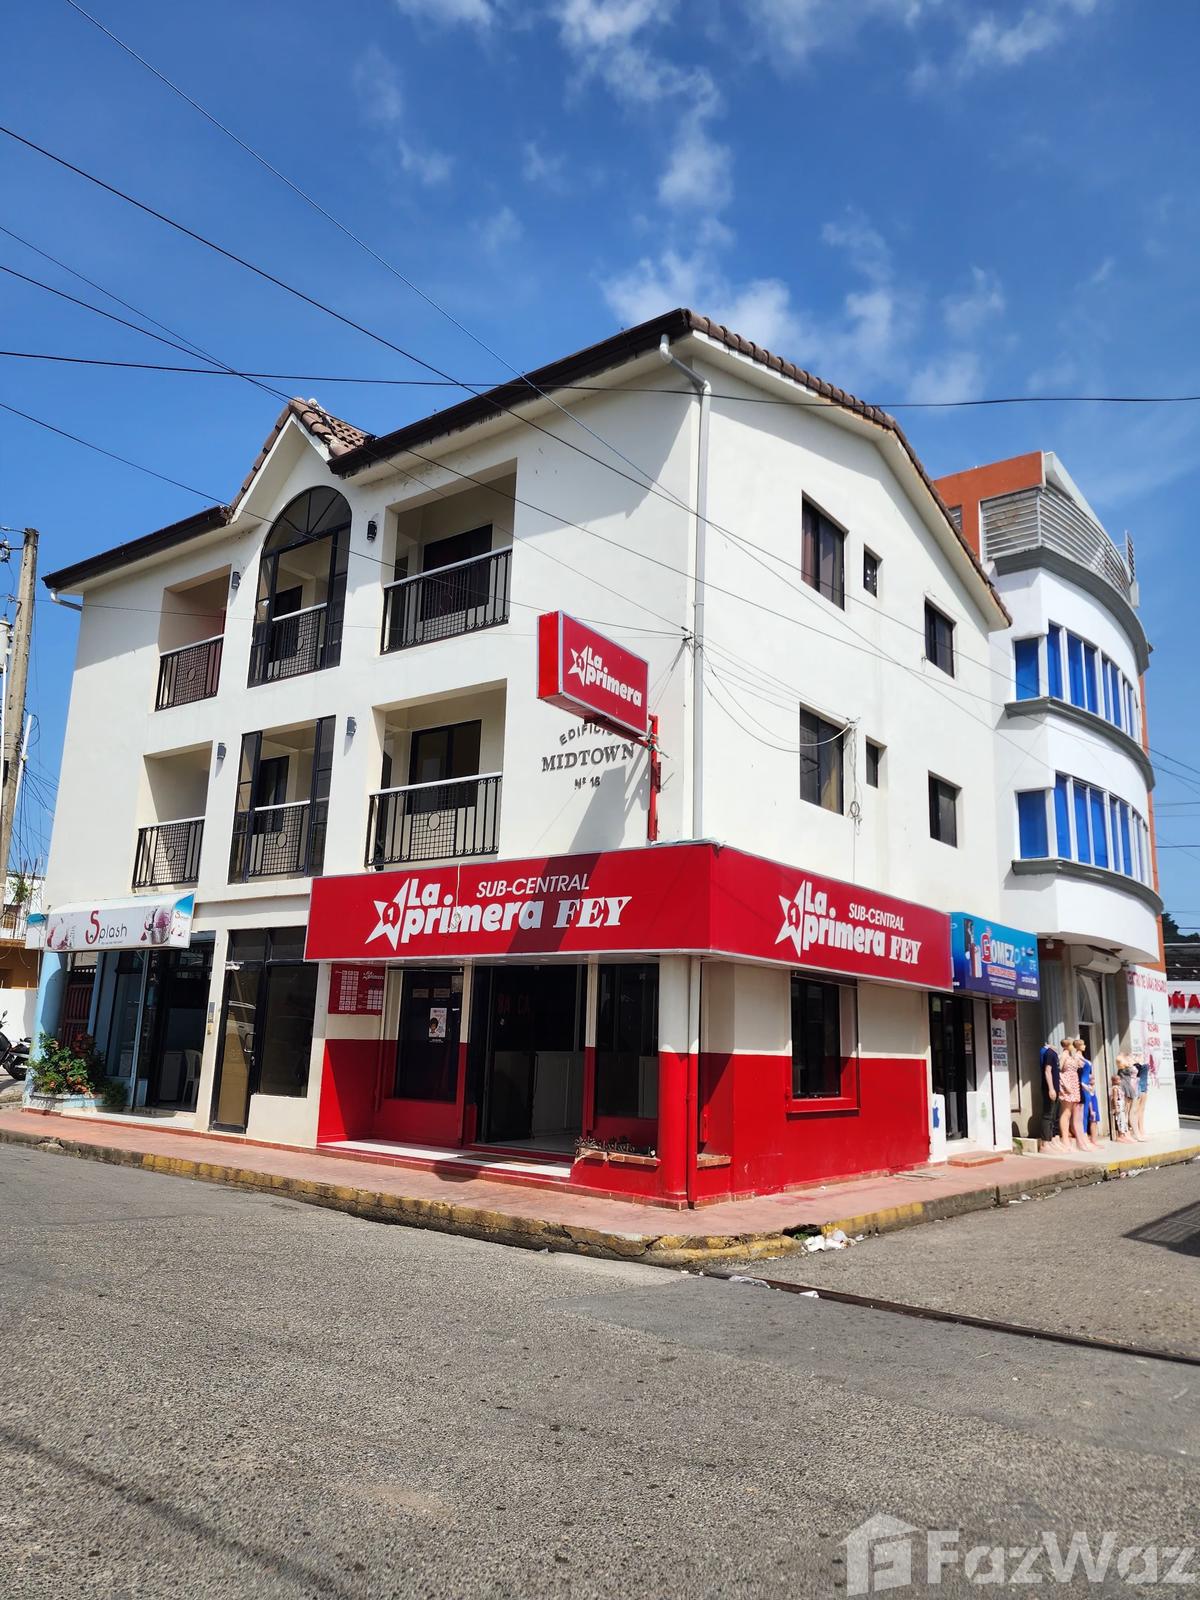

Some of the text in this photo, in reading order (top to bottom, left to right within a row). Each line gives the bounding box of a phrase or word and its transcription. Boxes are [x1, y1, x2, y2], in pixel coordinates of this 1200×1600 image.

[588, 648, 602, 669] La
[586, 666, 642, 707] primera
[542, 743, 635, 772] MIDTOWN
[407, 879, 440, 906] La
[476, 873, 590, 899] SUB-CENTRAL
[805, 883, 826, 913] La
[85, 910, 128, 944] Splash
[401, 894, 632, 943] primera FEY
[848, 903, 904, 930] SUB-CENTRAL
[802, 907, 922, 964] primera FEY
